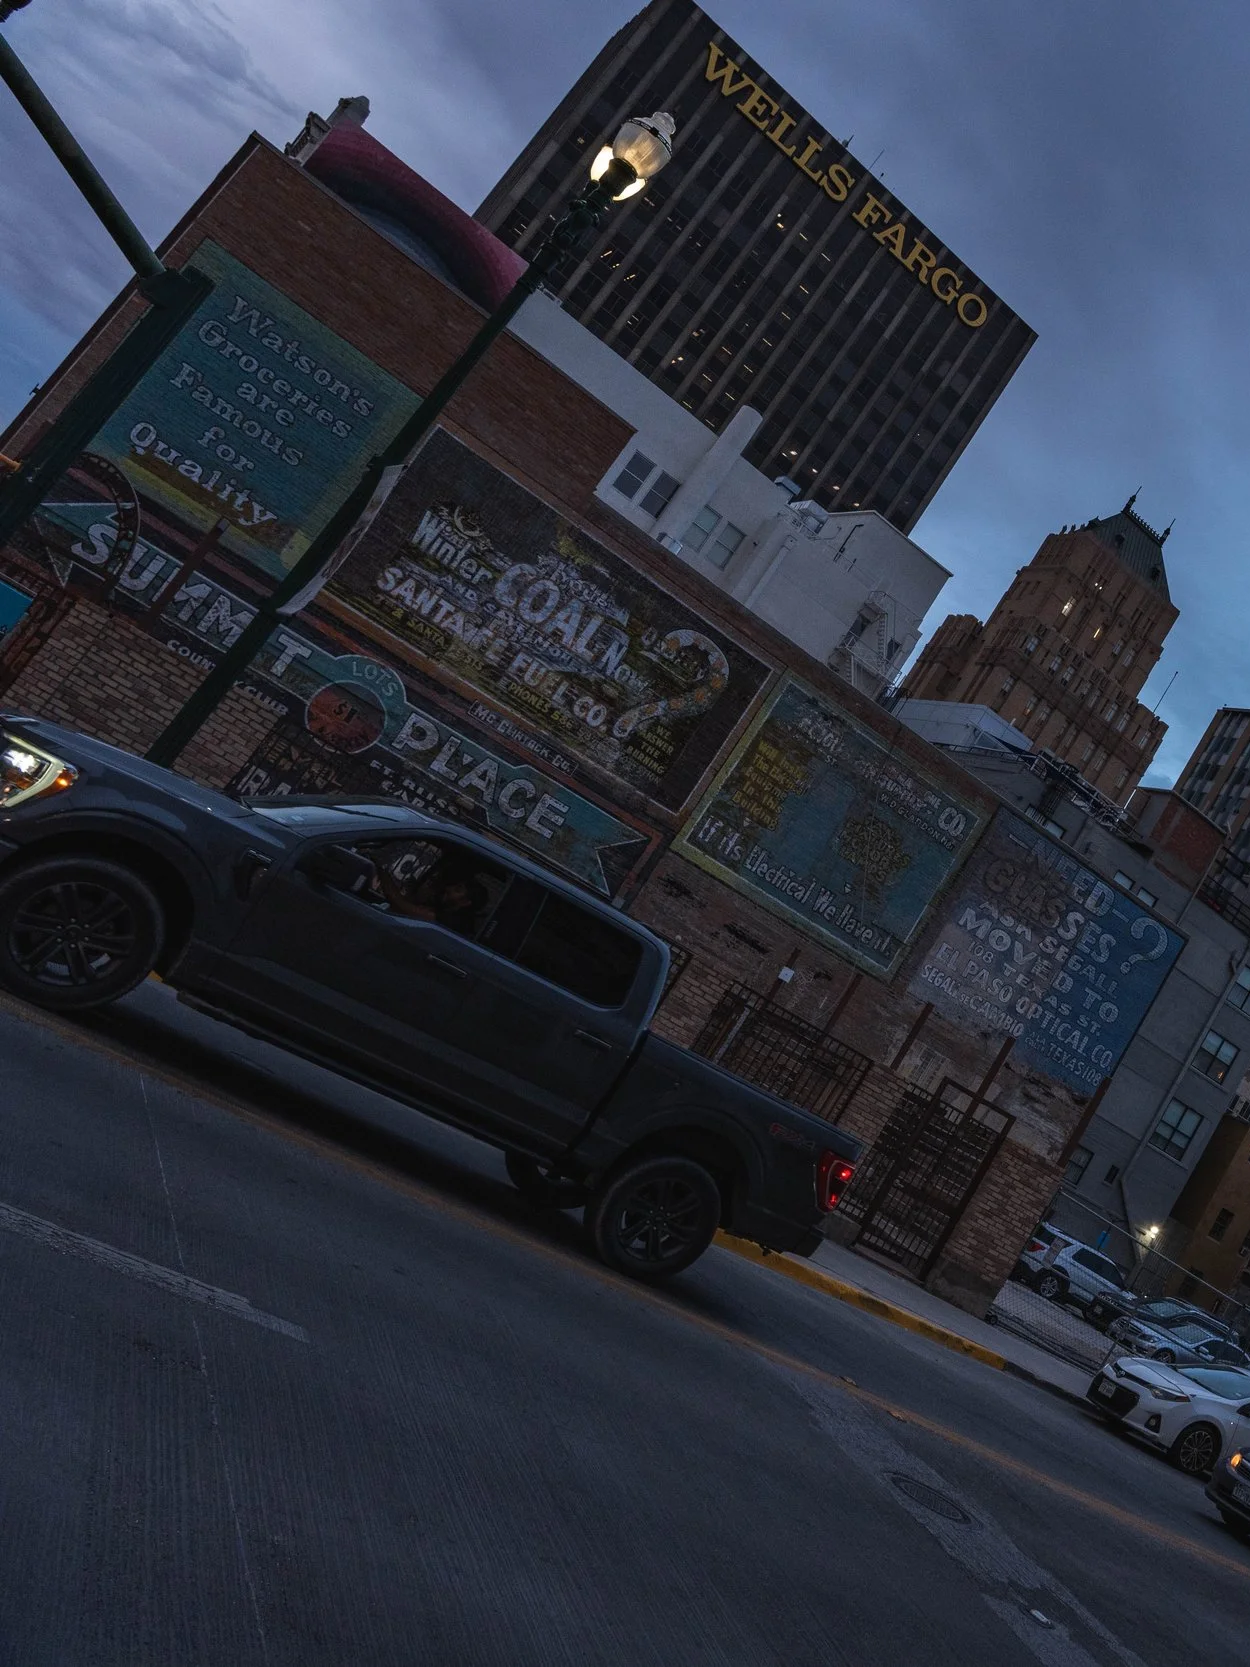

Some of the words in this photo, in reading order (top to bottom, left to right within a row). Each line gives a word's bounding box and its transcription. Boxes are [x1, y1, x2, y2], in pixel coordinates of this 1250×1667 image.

[702, 41, 857, 202] WELLS
[850, 191, 989, 328] FARGO
[195, 317, 354, 442] Groceries
[223, 294, 375, 420] Watson's
[234, 379, 297, 430] are
[168, 361, 305, 469] Famous
[195, 428, 257, 476] for
[127, 422, 277, 527] Quality
[409, 509, 495, 586] Winter
[493, 562, 606, 663] COAL
[67, 524, 313, 680] SUMMT
[390, 710, 571, 841] PLACE
[351, 661, 399, 696] LOTS
[374, 564, 467, 639] SANTA
[469, 626, 510, 665] FE
[506, 650, 572, 707] FUEL
[573, 694, 611, 734] CO.
[405, 615, 447, 648] SANTA
[507, 681, 552, 715] PHONES
[241, 683, 289, 717] CLUB
[637, 729, 675, 756] ANSWER
[654, 725, 672, 741] WE
[625, 745, 666, 776] BURNING
[639, 741, 661, 759] THE
[751, 752, 772, 773] The
[730, 790, 780, 833] Building
[760, 793, 785, 816] this
[742, 843, 817, 905] Electrical
[812, 887, 838, 921] We
[834, 902, 875, 945] Have
[982, 859, 1119, 966] GLASSES
[933, 941, 962, 973] EL
[961, 959, 1016, 1005] PASO
[1015, 994, 1095, 1057] OPTICAL
[1089, 1043, 1117, 1073] CO.
[957, 906, 1077, 996] MOVED
[1081, 986, 1123, 1021] TO
[966, 940, 996, 966] 108
[999, 963, 1073, 1018] TEXAS
[1076, 1013, 1102, 1038] ST.
[1037, 933, 1124, 1001] SEGALL
[1046, 1041, 1085, 1076] TEXAS
[1080, 1065, 1103, 1088] 108
